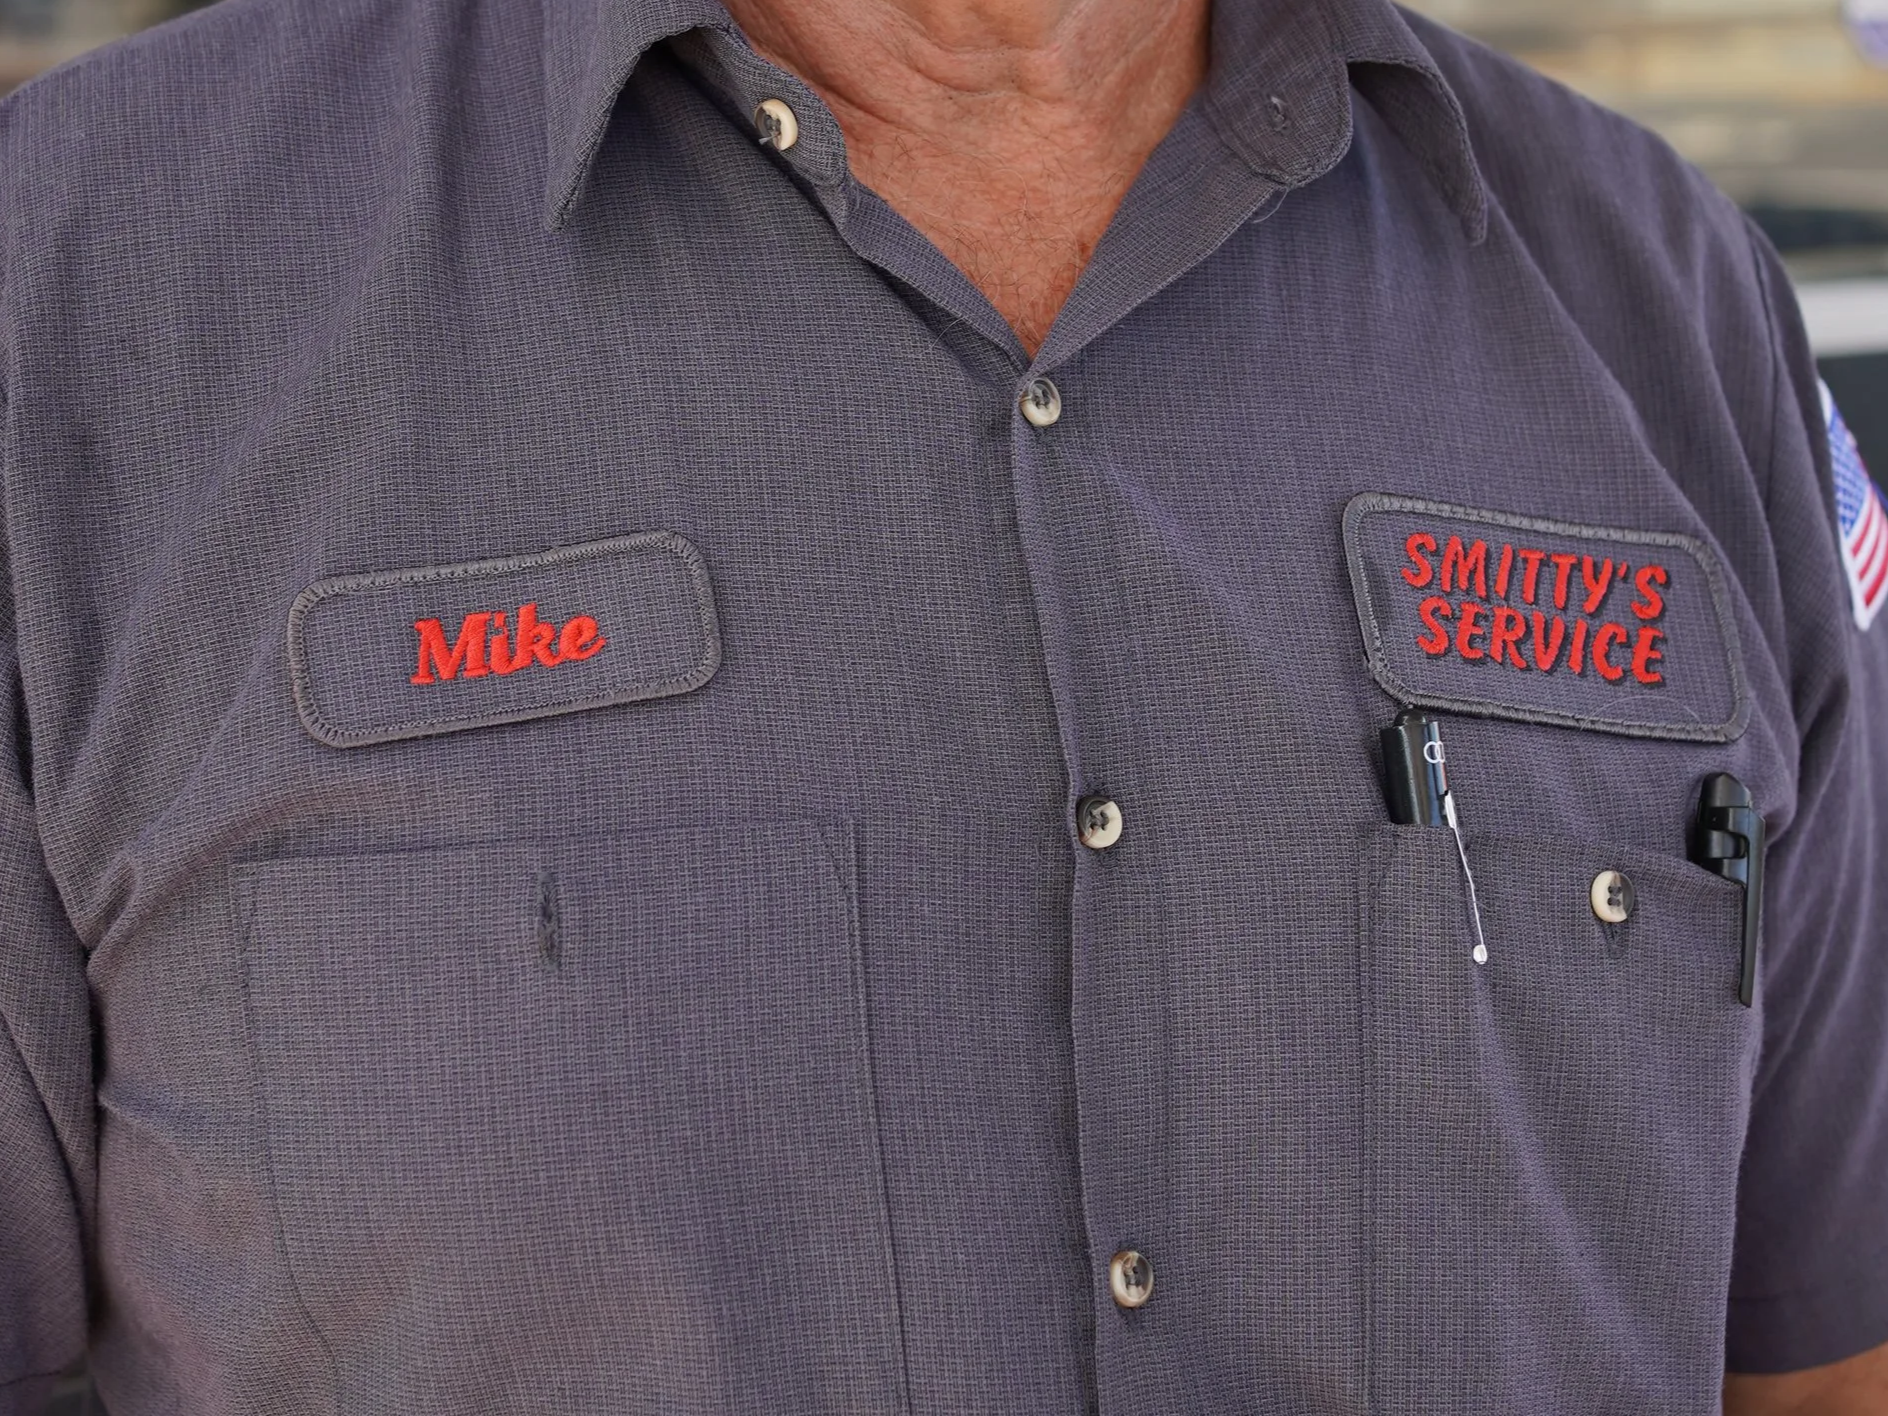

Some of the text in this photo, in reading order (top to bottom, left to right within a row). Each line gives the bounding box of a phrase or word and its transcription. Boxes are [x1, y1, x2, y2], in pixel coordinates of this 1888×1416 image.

[1402, 533, 1667, 619] SMITTY'S
[411, 603, 607, 685] Mike
[1417, 596, 1664, 683] SERVICE
